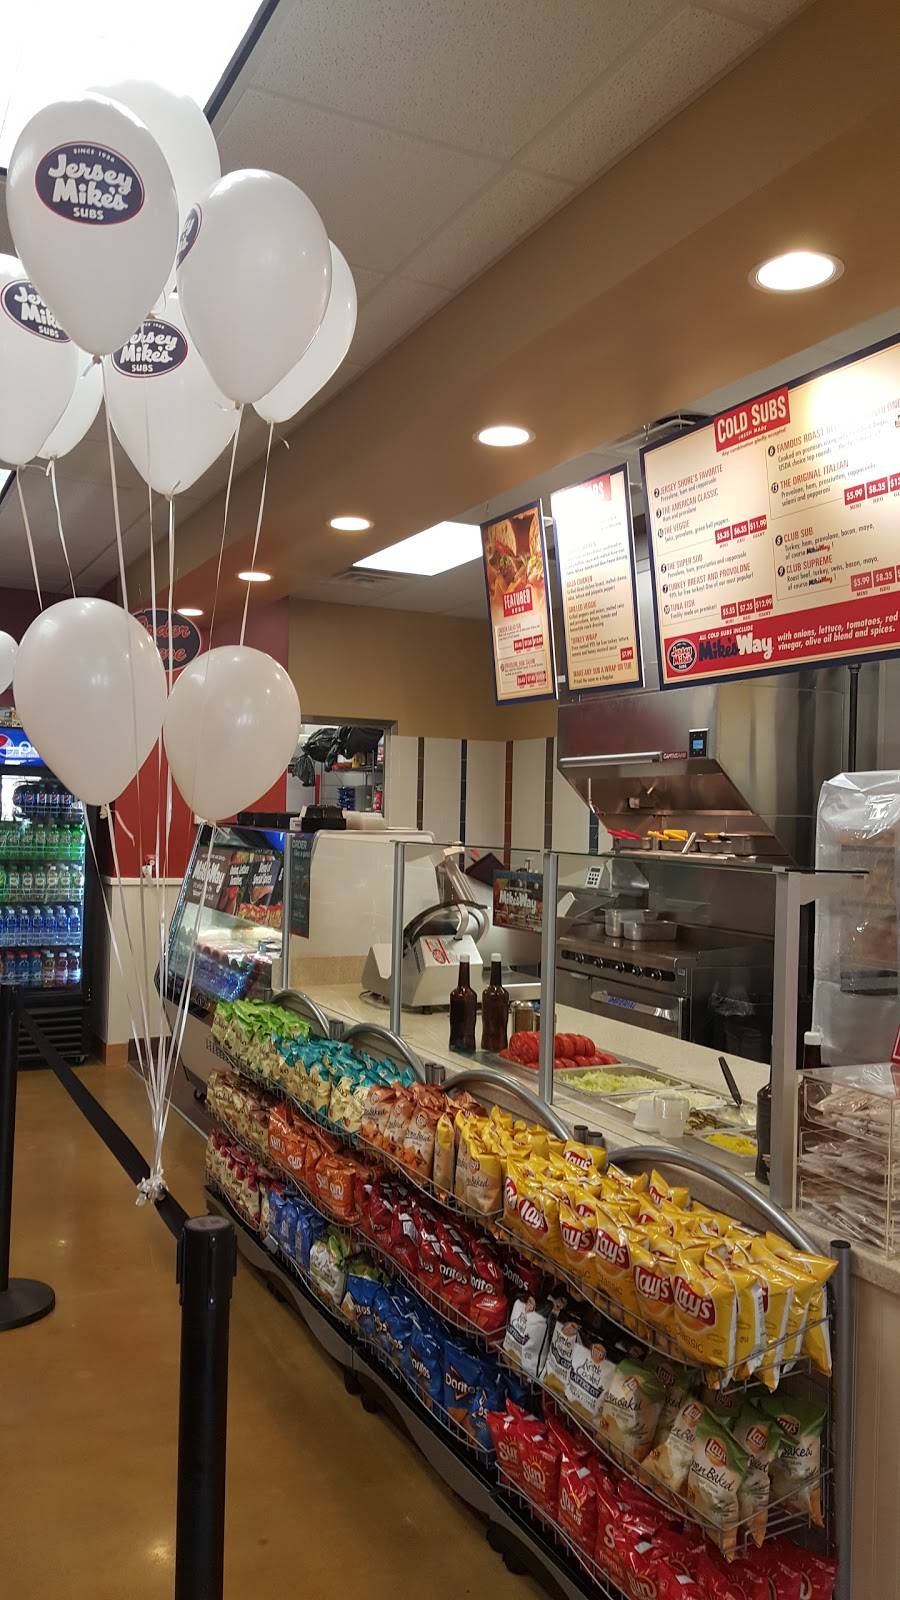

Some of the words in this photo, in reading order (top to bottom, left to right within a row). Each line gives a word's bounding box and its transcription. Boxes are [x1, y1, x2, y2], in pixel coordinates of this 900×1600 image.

[73, 147, 95, 155] SINCE
[48, 154, 133, 194] Jersey
[52, 178, 129, 210] Mike's
[73, 207, 104, 220] SUBS
[38, 325, 59, 339] SUBS
[129, 331, 178, 351] ersey
[120, 344, 173, 364] Mike's
[131, 364, 153, 373] SUBS
[718, 411, 748, 443] COLD
[751, 395, 787, 426] SUBS
[776, 436, 802, 453] FAMOUS
[778, 452, 795, 463] Cooked
[778, 462, 791, 472] USDA
[792, 458, 806, 467] choice
[806, 454, 815, 463] top
[660, 482, 676, 495] JERSEY
[699, 464, 724, 479] FAVORITE
[780, 478, 792, 489] THE
[792, 468, 821, 484] ORIGINAL
[823, 459, 849, 476] ITALIAN
[671, 496, 696, 511] AMERICAN
[697, 488, 719, 502] CLASSIC
[807, 488, 831, 499] pepperoni
[846, 488, 863, 501] $5.99
[869, 482, 886, 495] $8.35
[783, 531, 800, 542] CLUB
[801, 527, 814, 538] SUB
[677, 556, 692, 568] SUPER
[786, 562, 802, 574] CLUB
[803, 554, 833, 570] SUPREME
[669, 581, 686, 592] TURKEY
[687, 575, 706, 587] BREAST
[707, 571, 719, 581] AND
[719, 562, 751, 578] PROVOLONE
[787, 573, 800, 583] Roast
[875, 571, 893, 583] $8.35
[504, 588, 531, 609] FEATURED
[670, 602, 683, 612] TUNA
[684, 600, 695, 609] FISH
[707, 631, 720, 639] COLD
[720, 628, 732, 636] SUBS
[733, 625, 753, 633] INCLUDE
[777, 629, 792, 641] with
[793, 628, 817, 639] onions,
[818, 623, 844, 635] lettuce,
[846, 616, 883, 630] tomatoes,
[885, 610, 899, 623] red
[585, 633, 598, 641] WRAP
[778, 640, 804, 651] vinegar,
[805, 635, 821, 646] olive
[823, 634, 832, 643] oil
[833, 629, 853, 642] blend
[854, 627, 868, 638] and
[870, 625, 896, 638] spices.
[671, 646, 693, 657] Jersey
[673, 654, 693, 666] Mike's
[605, 664, 617, 673] WRAP
[440, 1264, 468, 1284] oritos
[472, 1274, 495, 1294] orito
[411, 1358, 432, 1380] oritos
[576, 1367, 601, 1385] Cooked
[583, 1358, 602, 1376] Kettle
[706, 1467, 735, 1492] Baked
